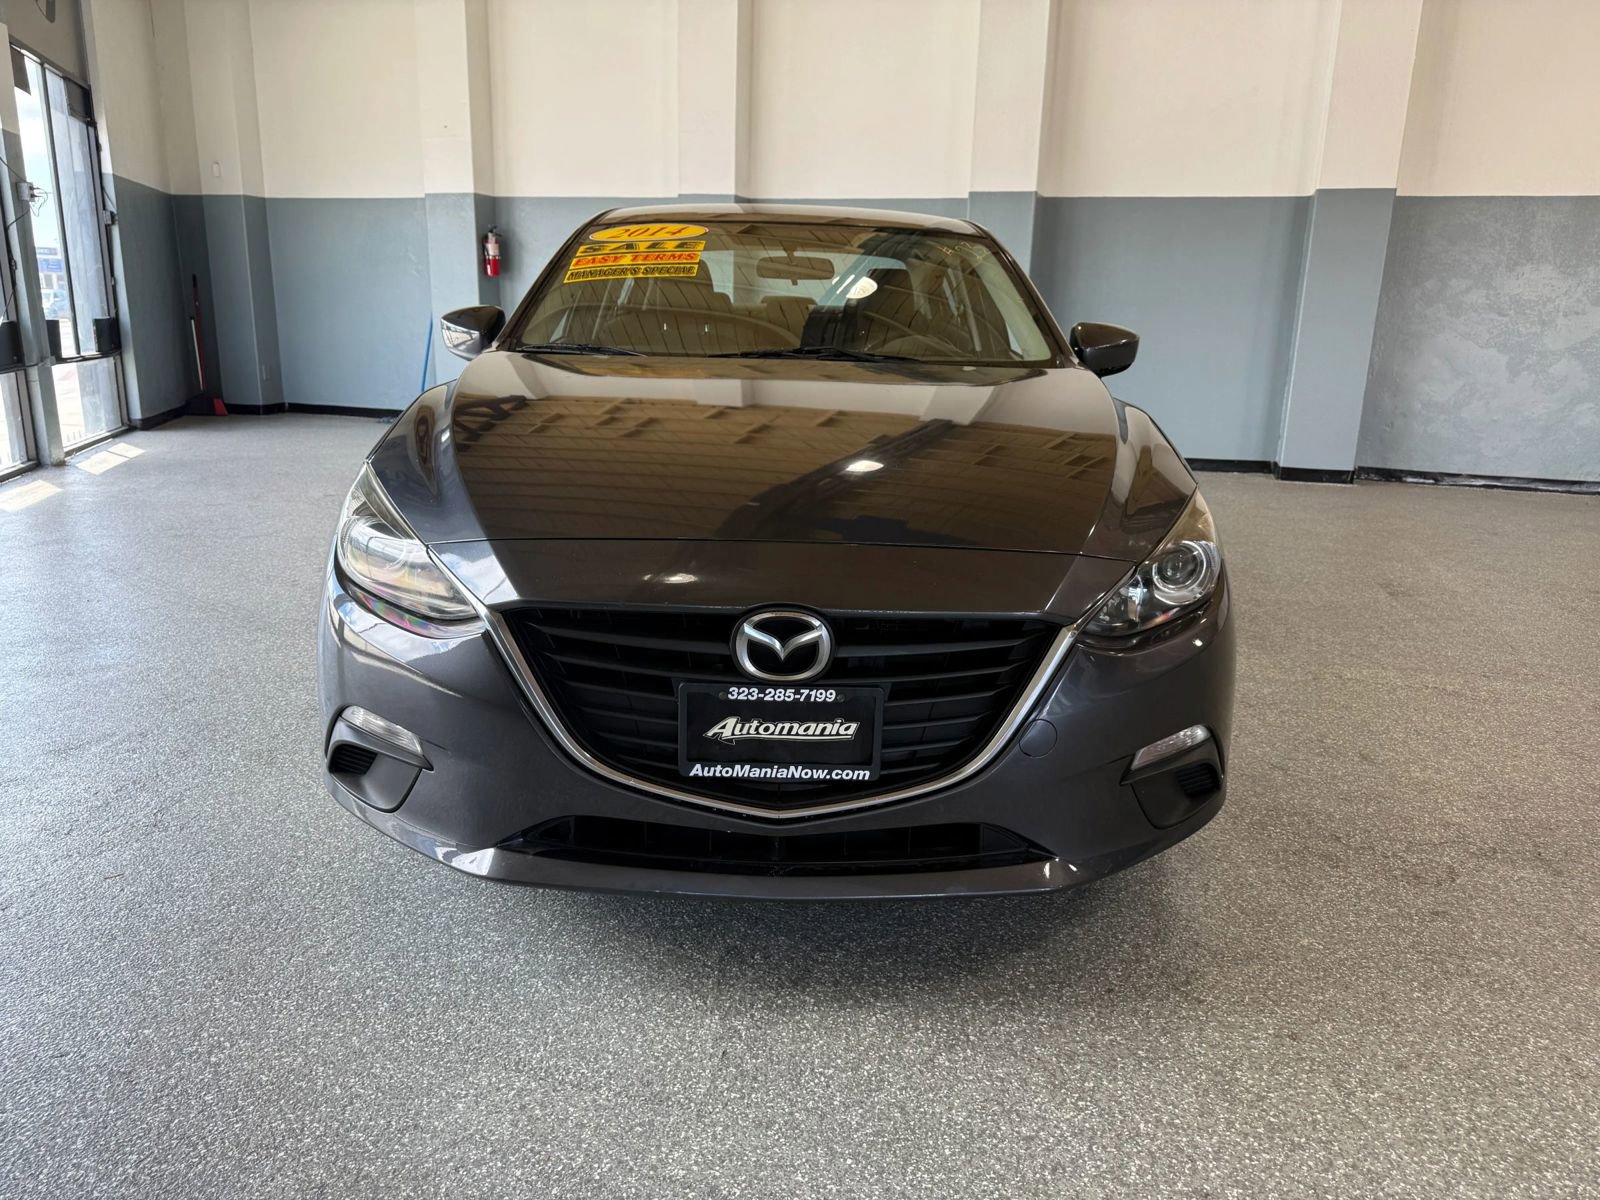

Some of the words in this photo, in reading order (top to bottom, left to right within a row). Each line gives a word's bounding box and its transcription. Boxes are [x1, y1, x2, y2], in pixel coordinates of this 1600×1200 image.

[607, 226, 690, 238] 2014
[580, 242, 699, 253] SALE
[574, 255, 625, 267] EASY
[631, 252, 699, 262] TERMS
[727, 687, 836, 703] 323-285-7199
[705, 717, 859, 740] Automania
[689, 763, 870, 780] AutoManiaNow.com
